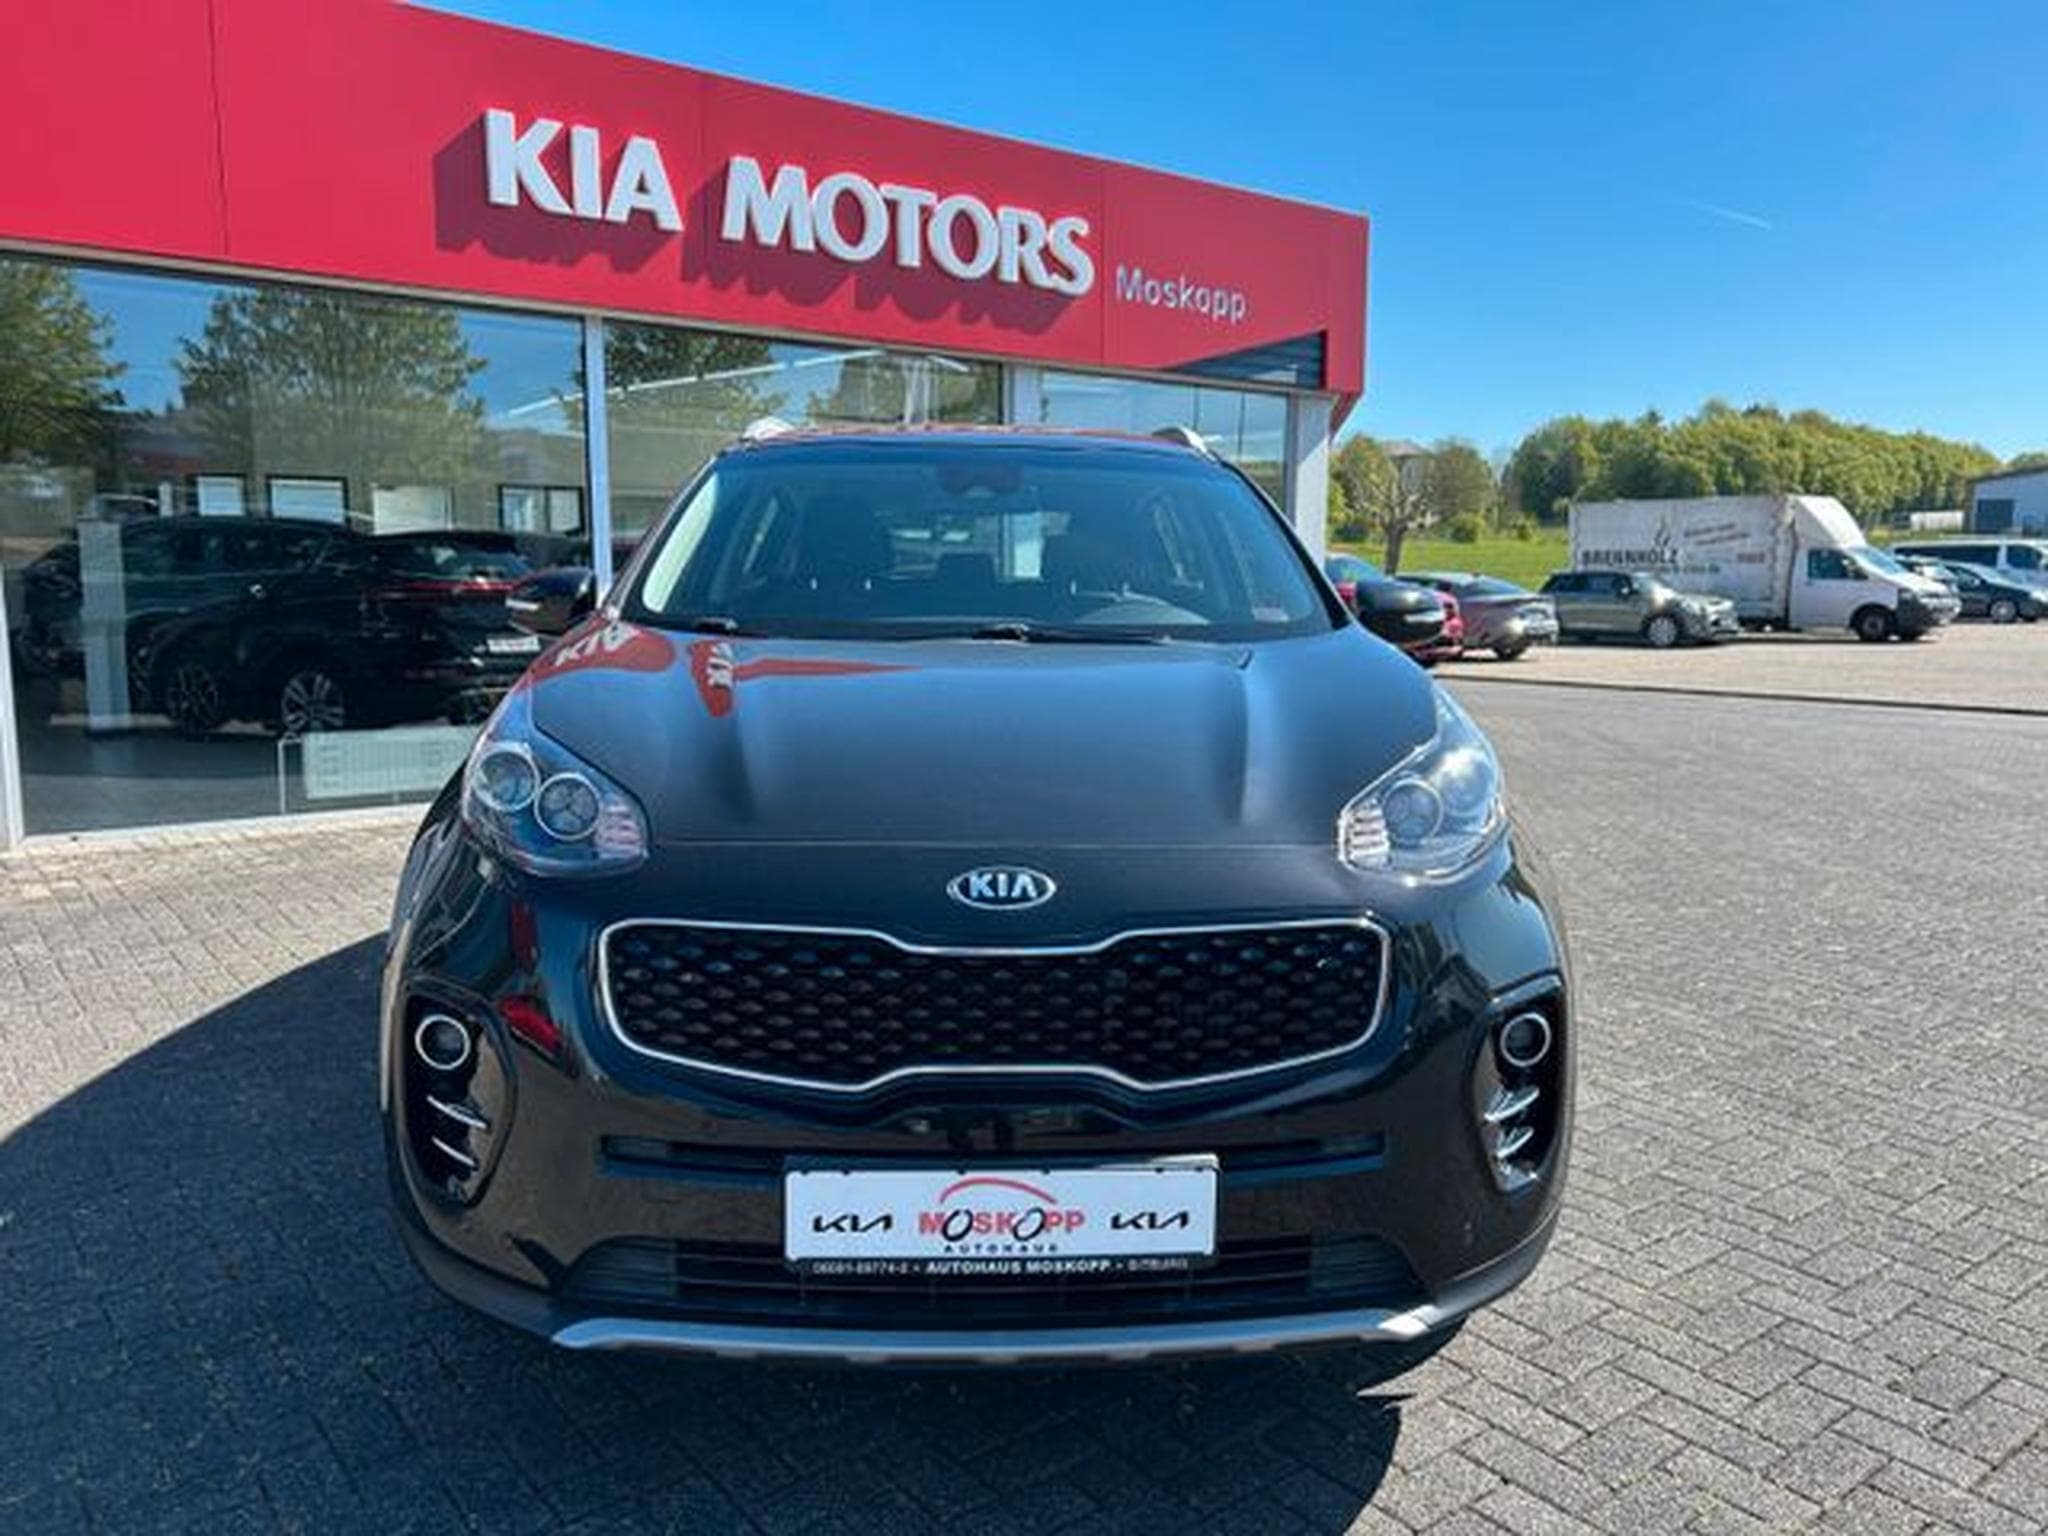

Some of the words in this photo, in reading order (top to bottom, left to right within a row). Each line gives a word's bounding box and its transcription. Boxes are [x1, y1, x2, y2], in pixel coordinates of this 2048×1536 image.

[485, 107, 684, 233] KIA
[721, 155, 1094, 295] MOTORS
[1116, 263, 1246, 325] Moskopp
[969, 870, 1038, 898] KIA
[919, 1207, 1086, 1242] MOSKOPP
[926, 1260, 1021, 1275] AUTOHAUS
[1025, 1257, 1112, 1274] MOSKOPP
